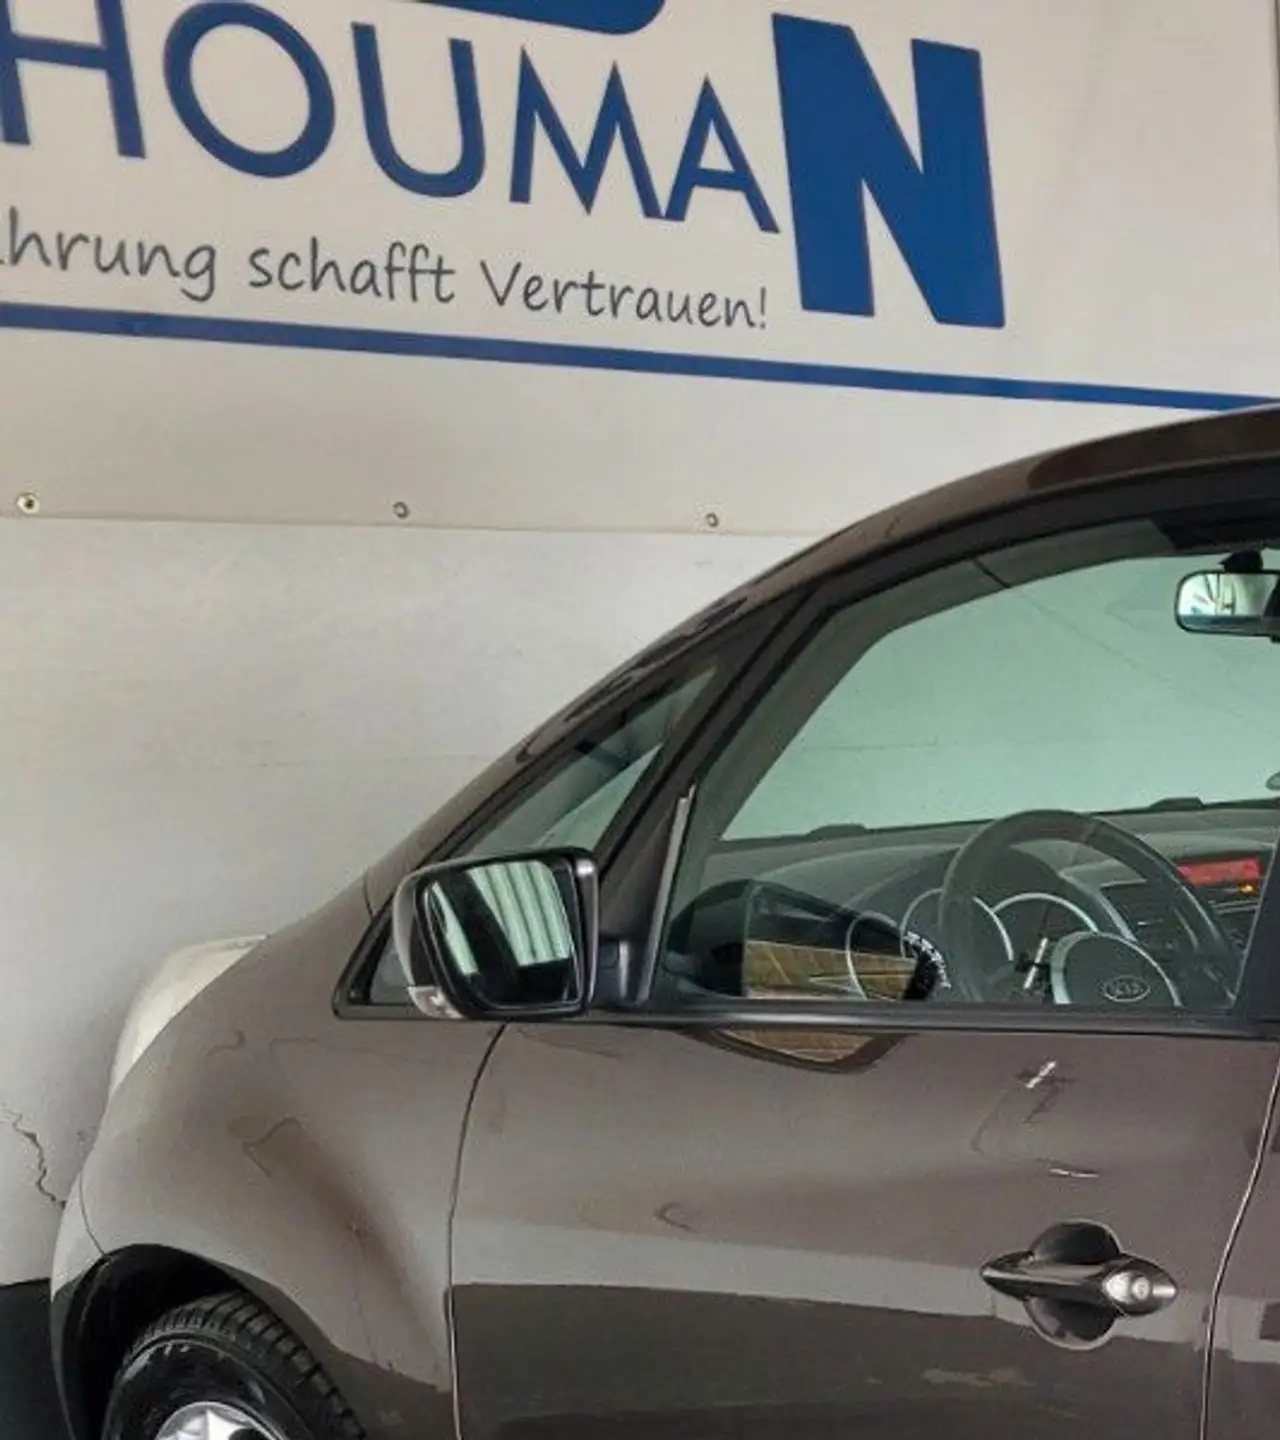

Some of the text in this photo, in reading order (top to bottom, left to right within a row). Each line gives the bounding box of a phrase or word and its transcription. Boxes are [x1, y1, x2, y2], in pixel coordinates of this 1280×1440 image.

[0, 206, 767, 330] hrung schafft Vertrauen!
